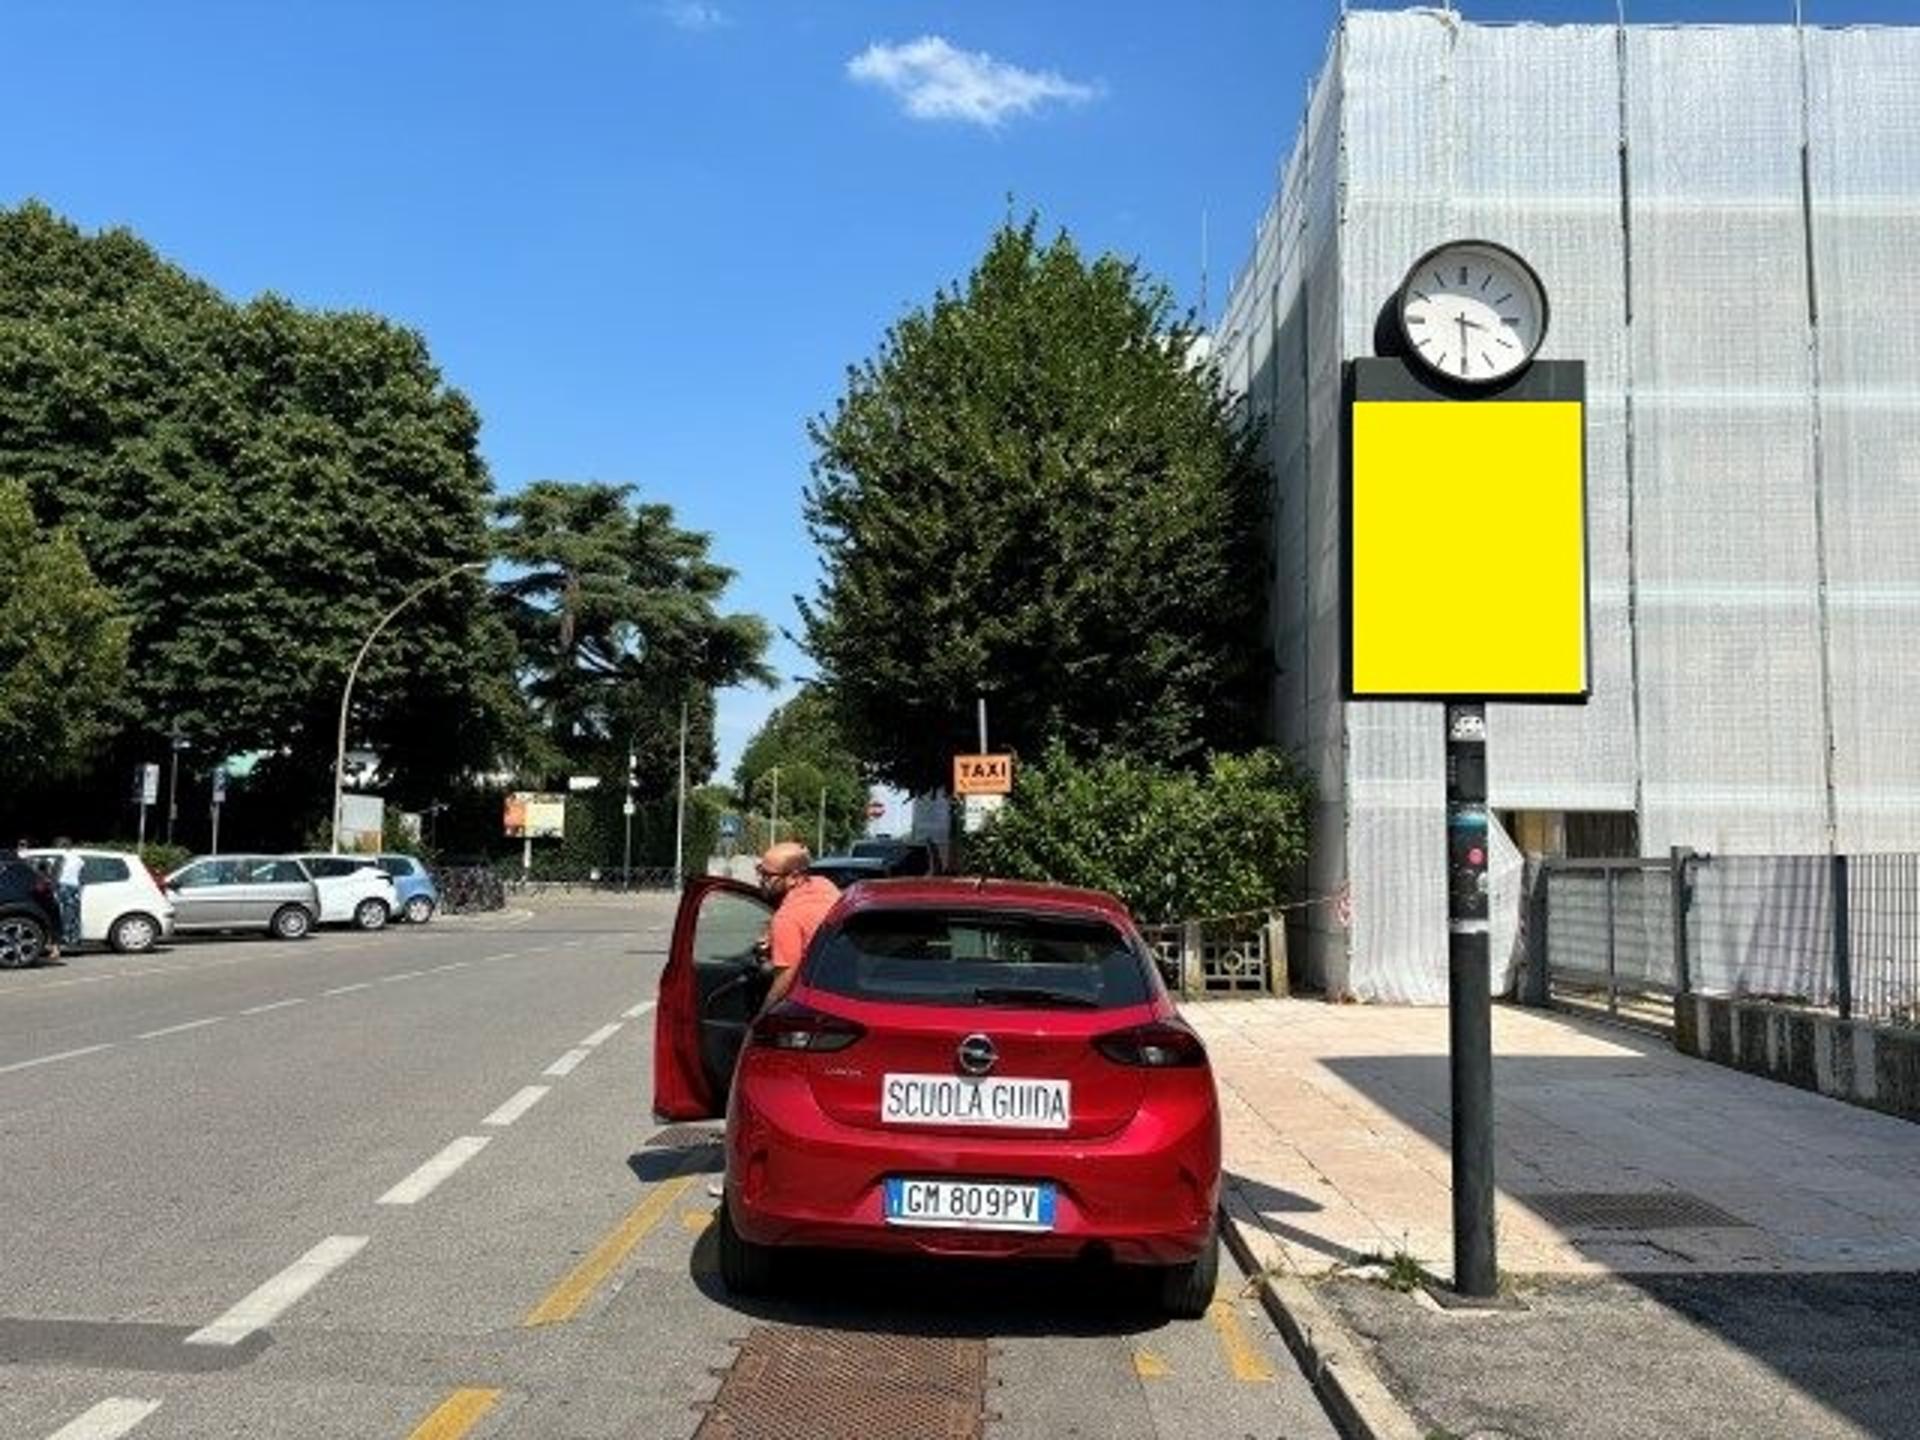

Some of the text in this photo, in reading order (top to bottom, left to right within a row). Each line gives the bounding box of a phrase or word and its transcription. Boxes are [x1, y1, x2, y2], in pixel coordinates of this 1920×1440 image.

[960, 761, 1006, 777] TAXI
[888, 1080, 1066, 1121] SCUOLA GUIDA
[907, 1185, 1036, 1218] GM 809PV
